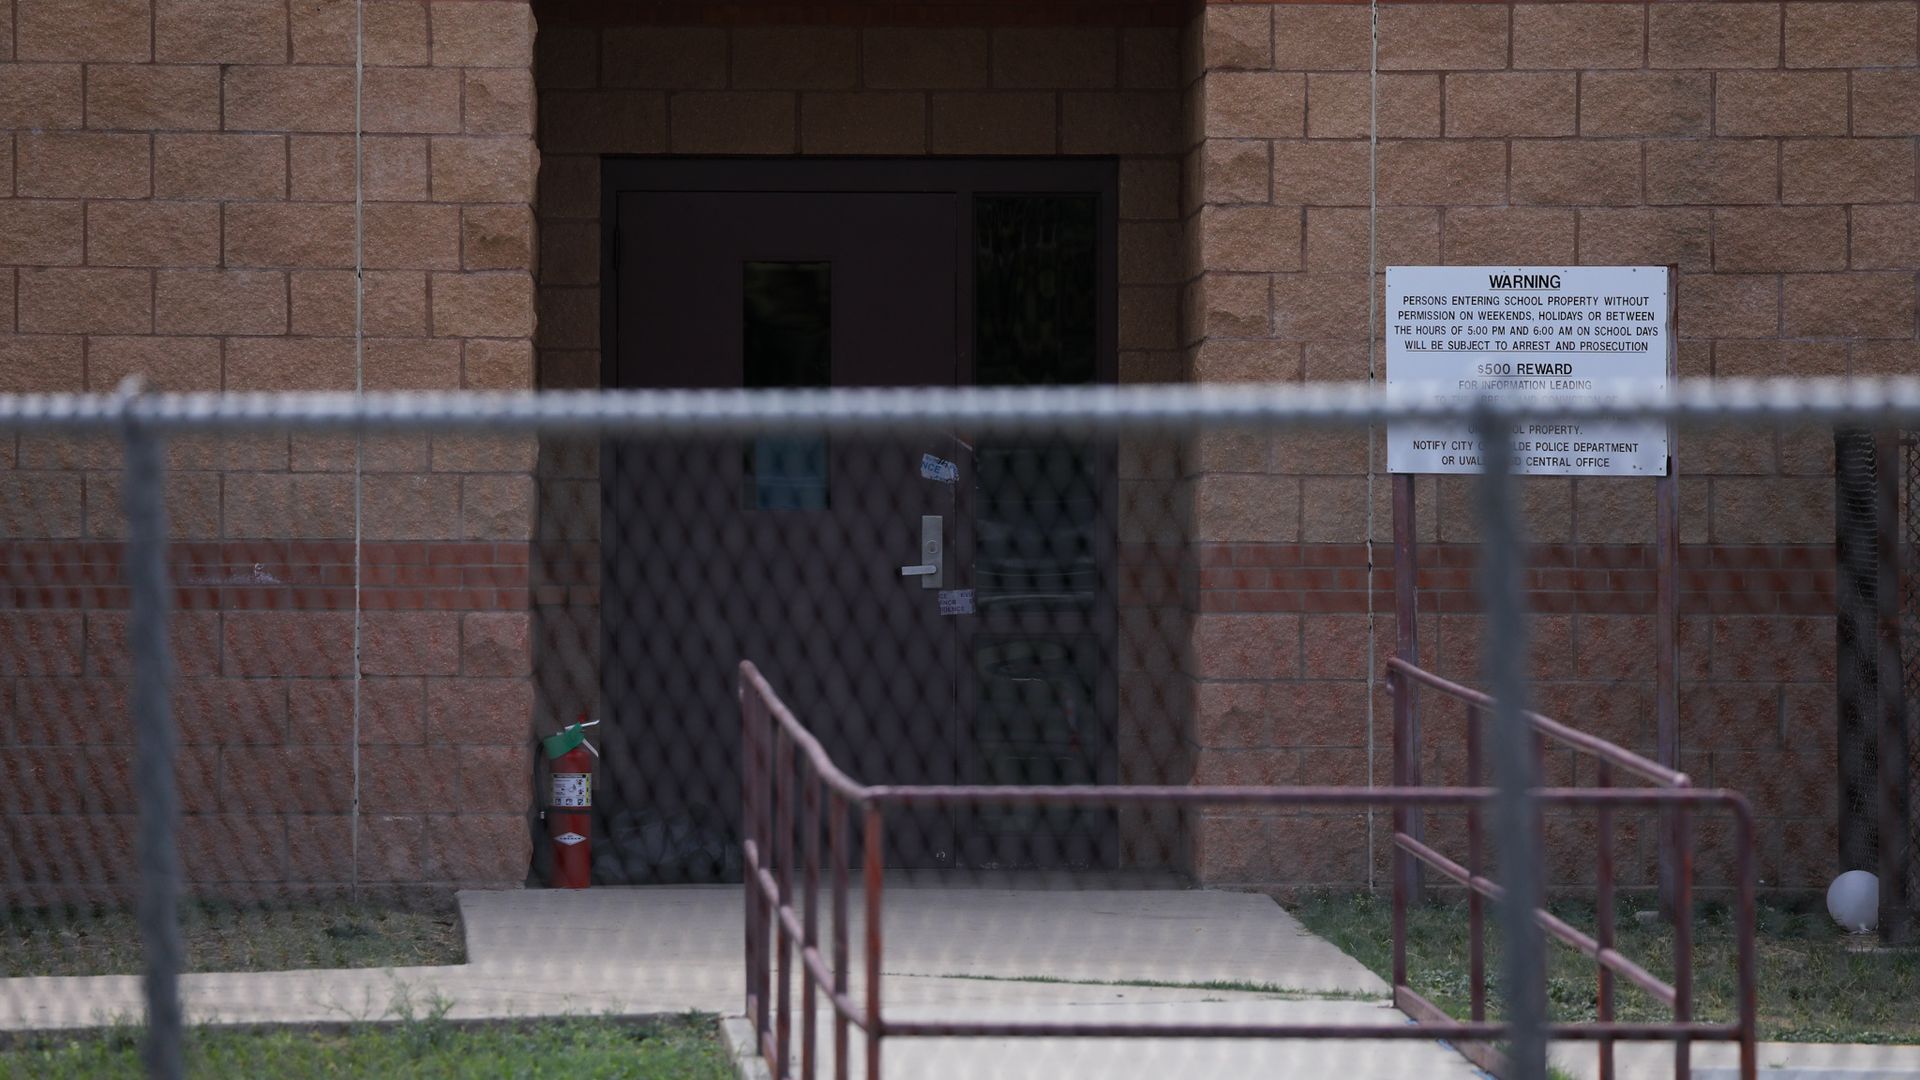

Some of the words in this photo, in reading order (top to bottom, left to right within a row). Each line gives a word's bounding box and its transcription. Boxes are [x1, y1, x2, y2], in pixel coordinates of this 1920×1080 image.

[1489, 274, 1561, 289] WARNING
[1403, 295, 1448, 306] PERSONS
[1452, 295, 1500, 306] ENTERING
[1504, 295, 1543, 306] SCHOOL
[1548, 295, 1599, 306] PROPERTY
[1603, 295, 1650, 306] WITHOUT
[1398, 310, 1455, 321] PERMISSION
[1459, 310, 1474, 321] ON
[1478, 310, 1535, 321] WEEKENDS,
[1538, 310, 1583, 321] HOLIDAYS
[1588, 310, 1602, 321] OR
[1606, 310, 1655, 321] BETWEEN
[1394, 325, 1412, 336] THE
[1415, 325, 1446, 336] HOURS
[1450, 325, 1463, 336] OF
[1467, 325, 1488, 336] 5:00
[1492, 325, 1506, 336] PM
[1509, 325, 1529, 336] AND
[1533, 325, 1554, 336] 6:00
[1558, 325, 1573, 336] AM
[1577, 325, 1590, 336] ON
[1594, 325, 1632, 336] SCHOOL
[1636, 325, 1659, 336] DAYS
[1404, 340, 1427, 351] WILL
[1431, 340, 1443, 351] BE
[1448, 340, 1490, 351] SUBJECT
[1495, 340, 1508, 351] TO
[1512, 340, 1550, 351] ARREST
[1555, 340, 1576, 351] AND
[1580, 340, 1649, 351] PROSECUTION
[1477, 363, 1511, 375] $500
[1517, 363, 1573, 375] REWARD
[1458, 380, 1478, 390] FOR
[1482, 380, 1546, 390] INFORMATION
[1550, 380, 1592, 390] LEADING
[1529, 425, 1583, 435] PROPERTY.
[1413, 440, 1447, 450] NOTIFY
[1451, 441, 1474, 451] CITY
[1535, 442, 1569, 452] POLICE
[1573, 442, 1639, 453] DEPARTMENT
[1441, 456, 1455, 465] OR
[1526, 456, 1570, 467] CENTRAL
[1576, 457, 1610, 467] OFFICE
